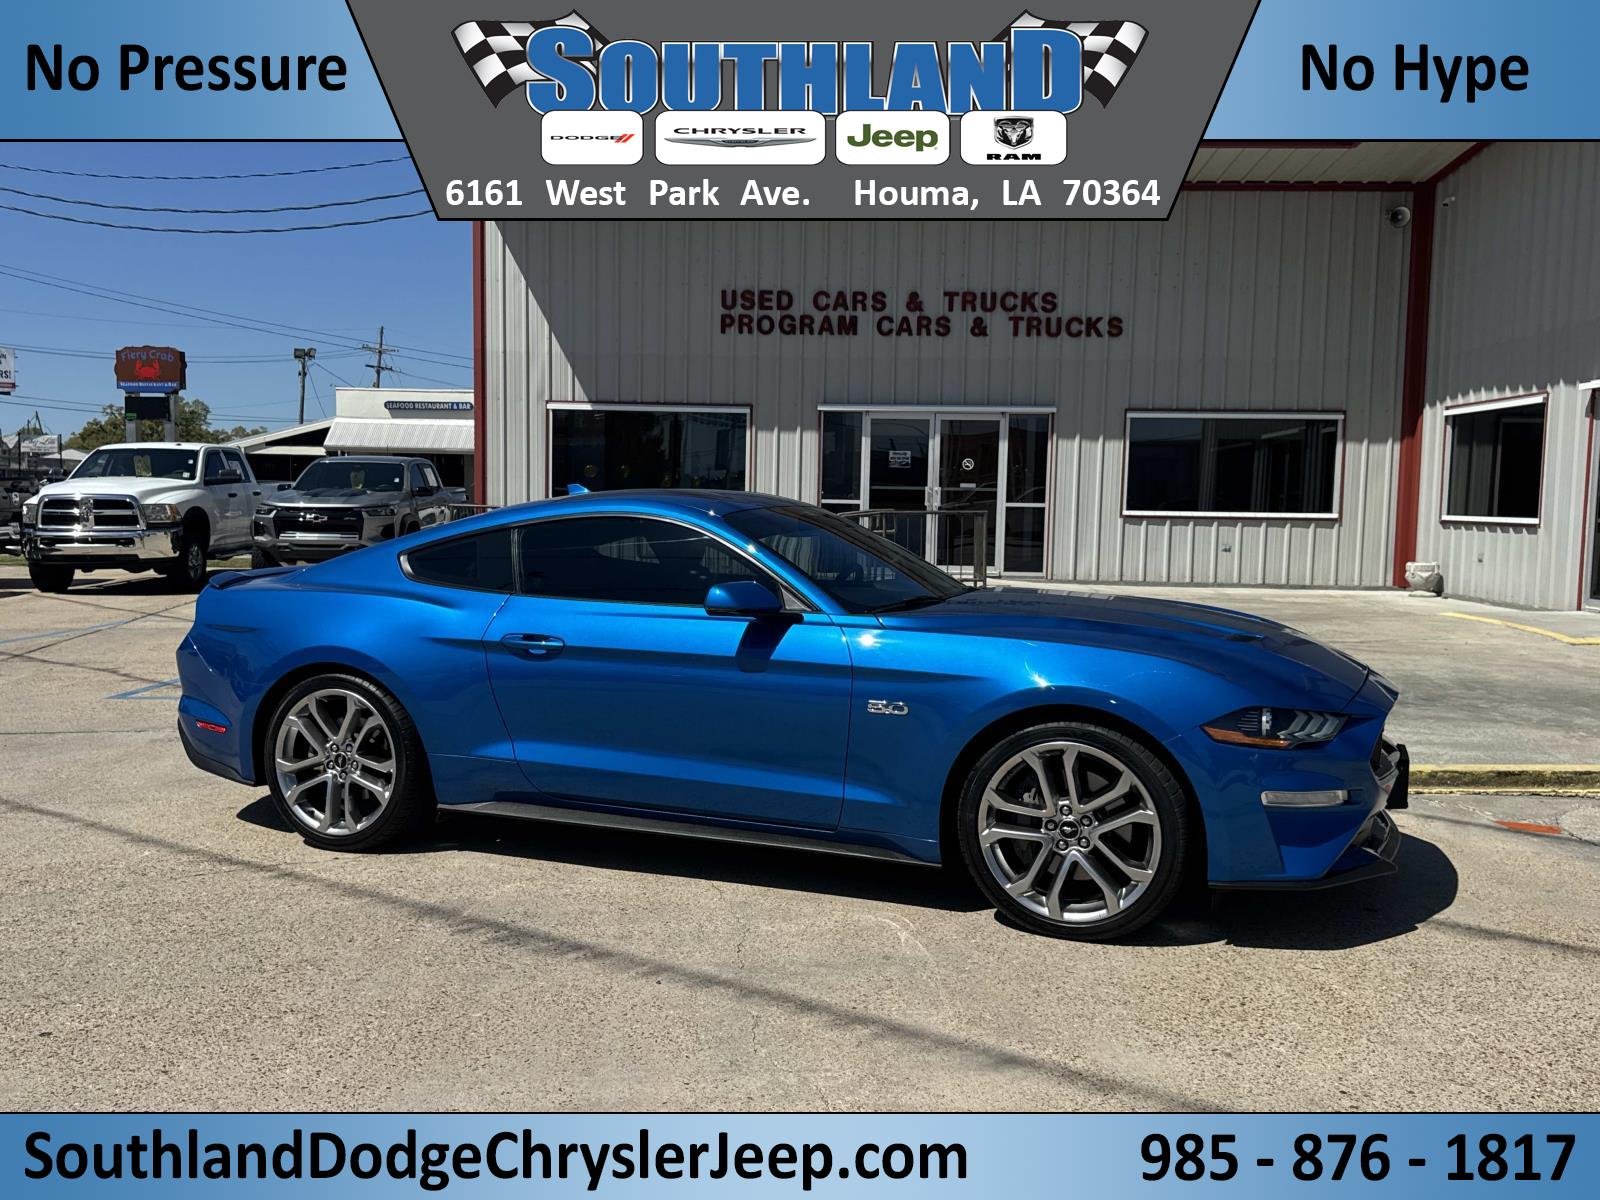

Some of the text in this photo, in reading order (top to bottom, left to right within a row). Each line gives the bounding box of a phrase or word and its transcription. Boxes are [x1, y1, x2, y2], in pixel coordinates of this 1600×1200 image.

[720, 289, 1058, 314] USED CARS & TRUCKS
[720, 313, 1123, 338] PROGRAM CARS & TRUCKS
